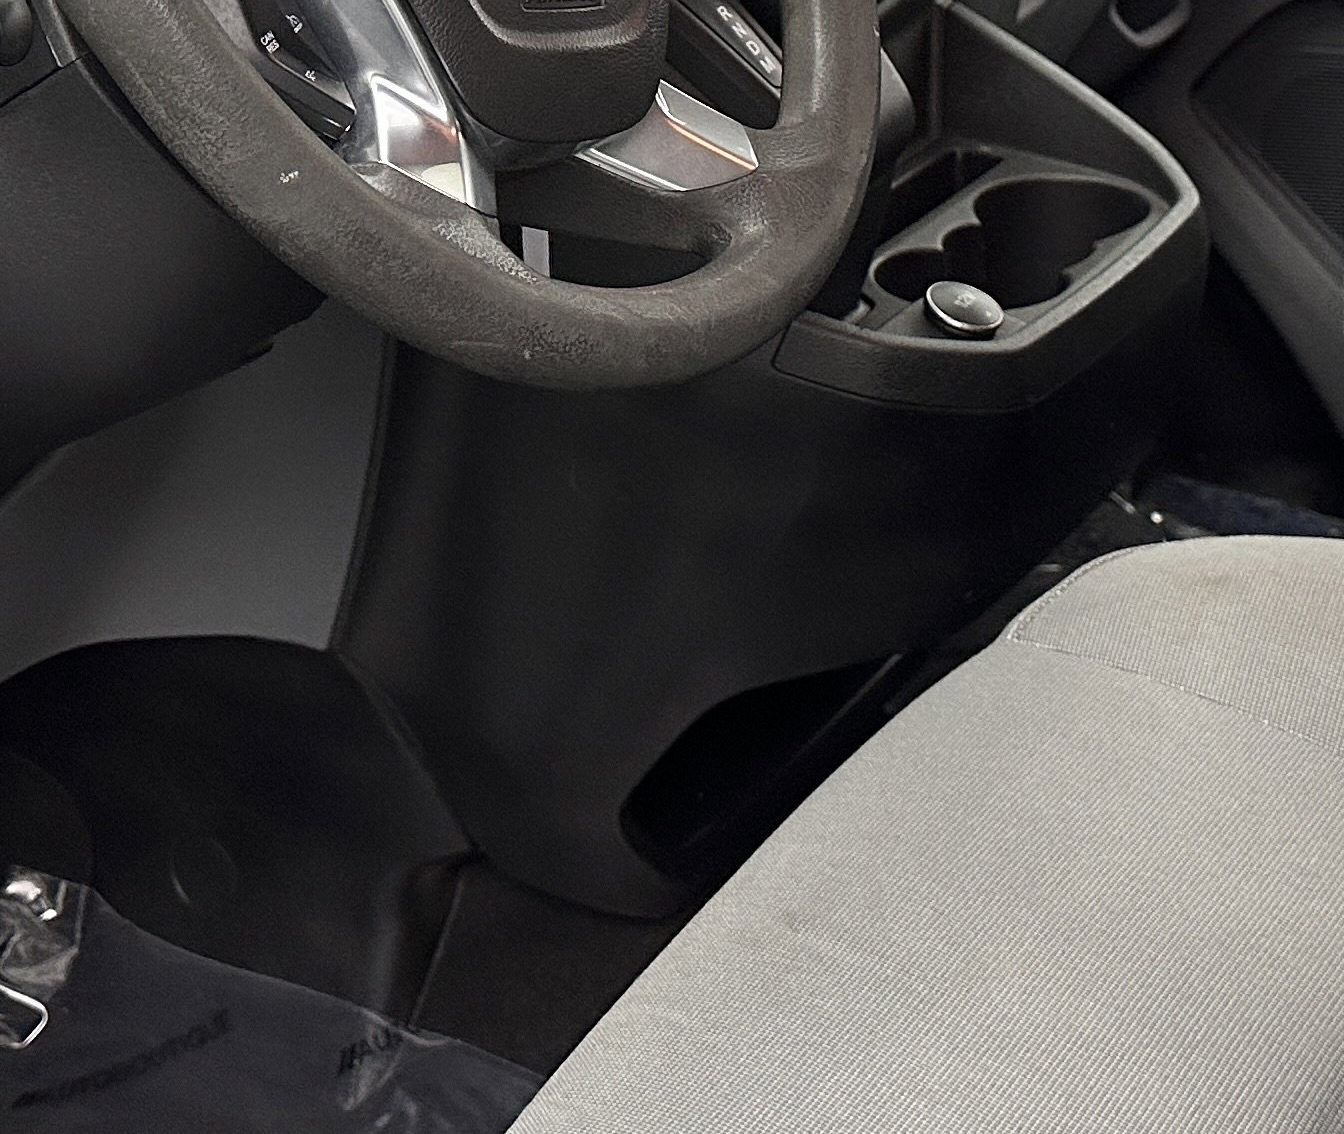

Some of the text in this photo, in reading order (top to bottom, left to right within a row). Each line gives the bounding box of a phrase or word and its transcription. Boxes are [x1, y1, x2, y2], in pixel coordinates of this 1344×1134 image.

[716, 5, 734, 21] R
[731, 22, 747, 39] N
[745, 40, 761, 56] D
[759, 56, 777, 74] M
